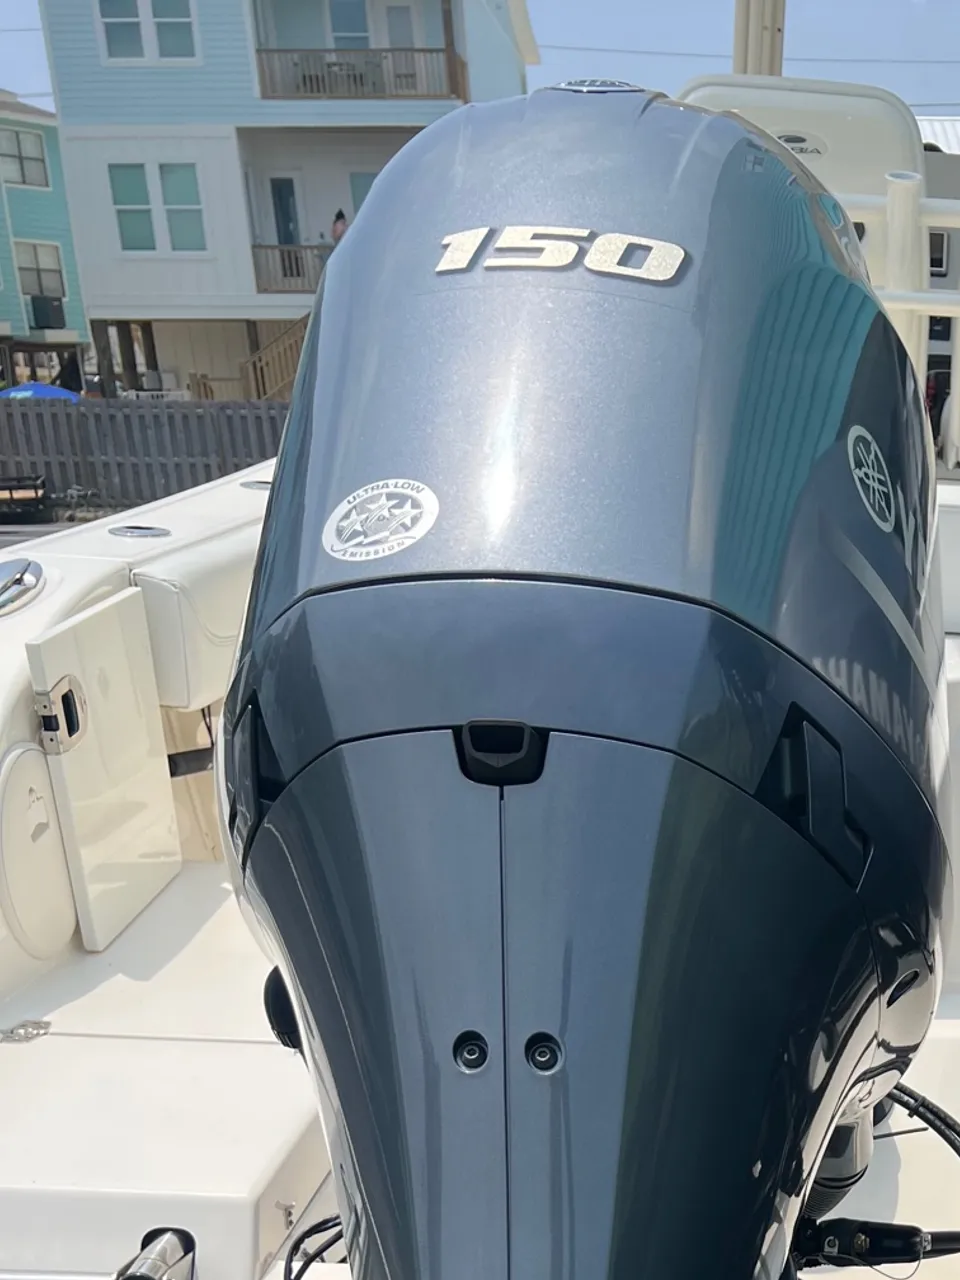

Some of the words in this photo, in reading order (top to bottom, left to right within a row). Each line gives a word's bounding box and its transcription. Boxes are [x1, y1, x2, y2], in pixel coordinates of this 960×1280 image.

[790, 147, 822, 155] BIA
[434, 225, 686, 282] 150
[340, 540, 405, 558] EMISSION
